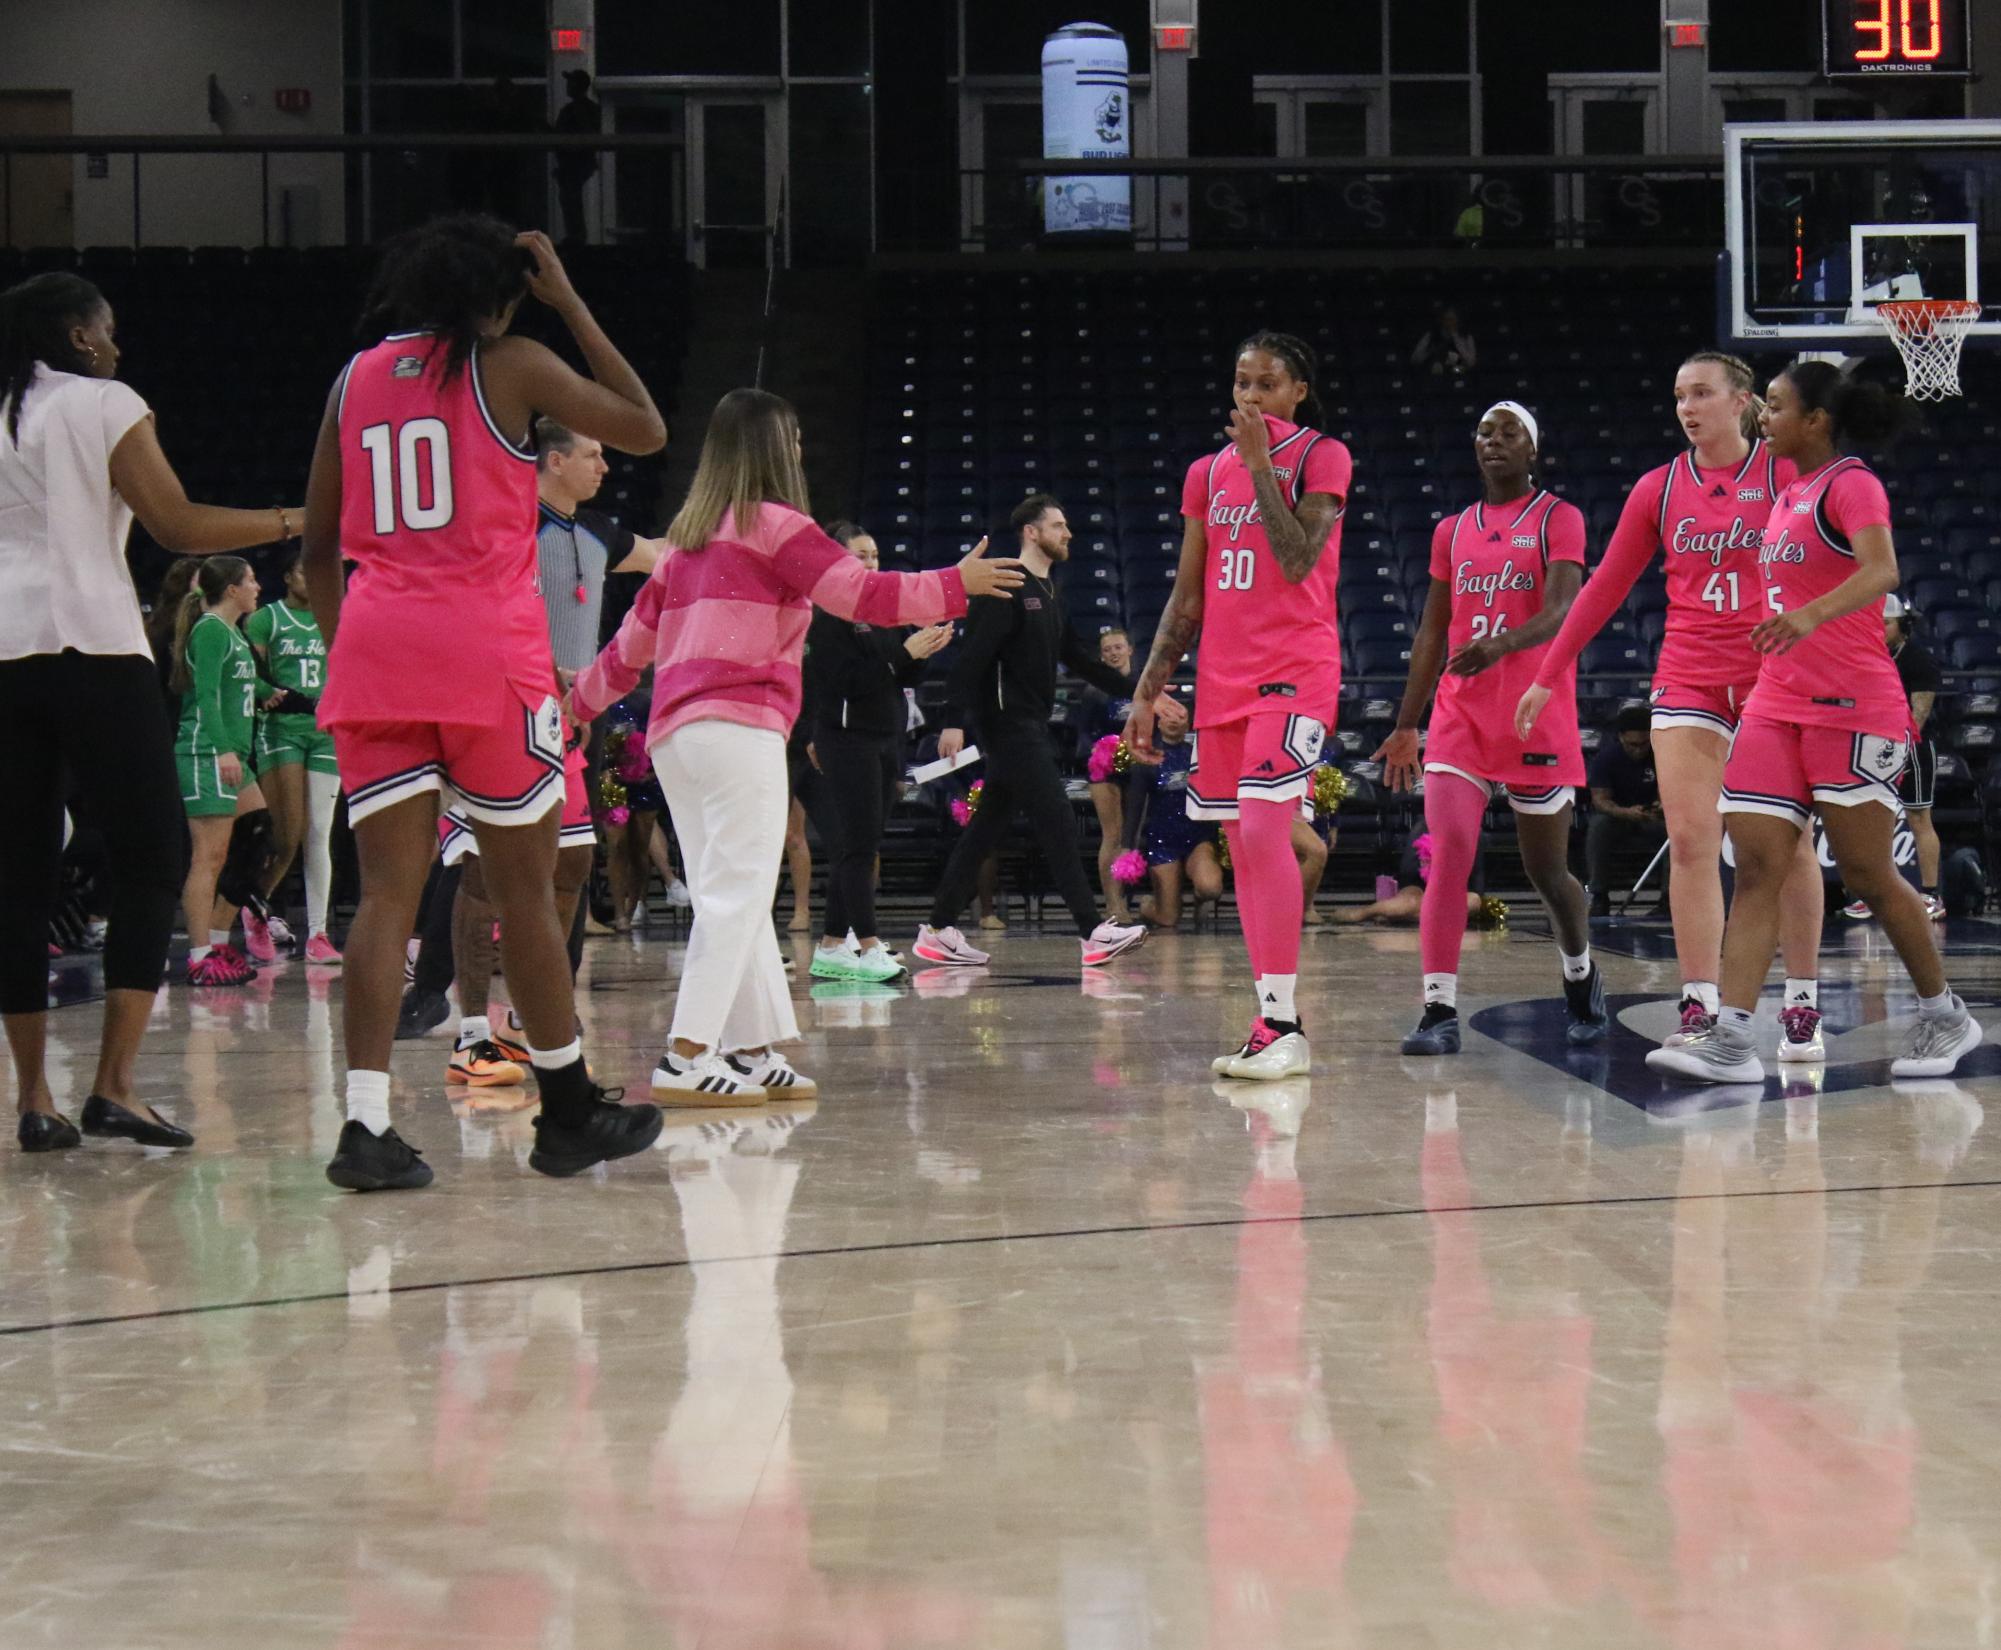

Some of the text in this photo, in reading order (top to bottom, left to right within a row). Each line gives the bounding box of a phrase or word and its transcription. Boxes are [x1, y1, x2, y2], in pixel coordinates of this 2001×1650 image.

[1854, 0, 1941, 60] 30
[1861, 64, 1932, 72] DAKTRONICS
[1743, 328, 1779, 337] SPALDING
[361, 416, 454, 535] 10
[1208, 489, 1263, 541] Eagl
[1218, 548, 1255, 590] 30
[1455, 559, 1535, 608] Eagles
[1701, 571, 1739, 612] 41
[280, 638, 326, 656] The He
[299, 658, 321, 688] 13
